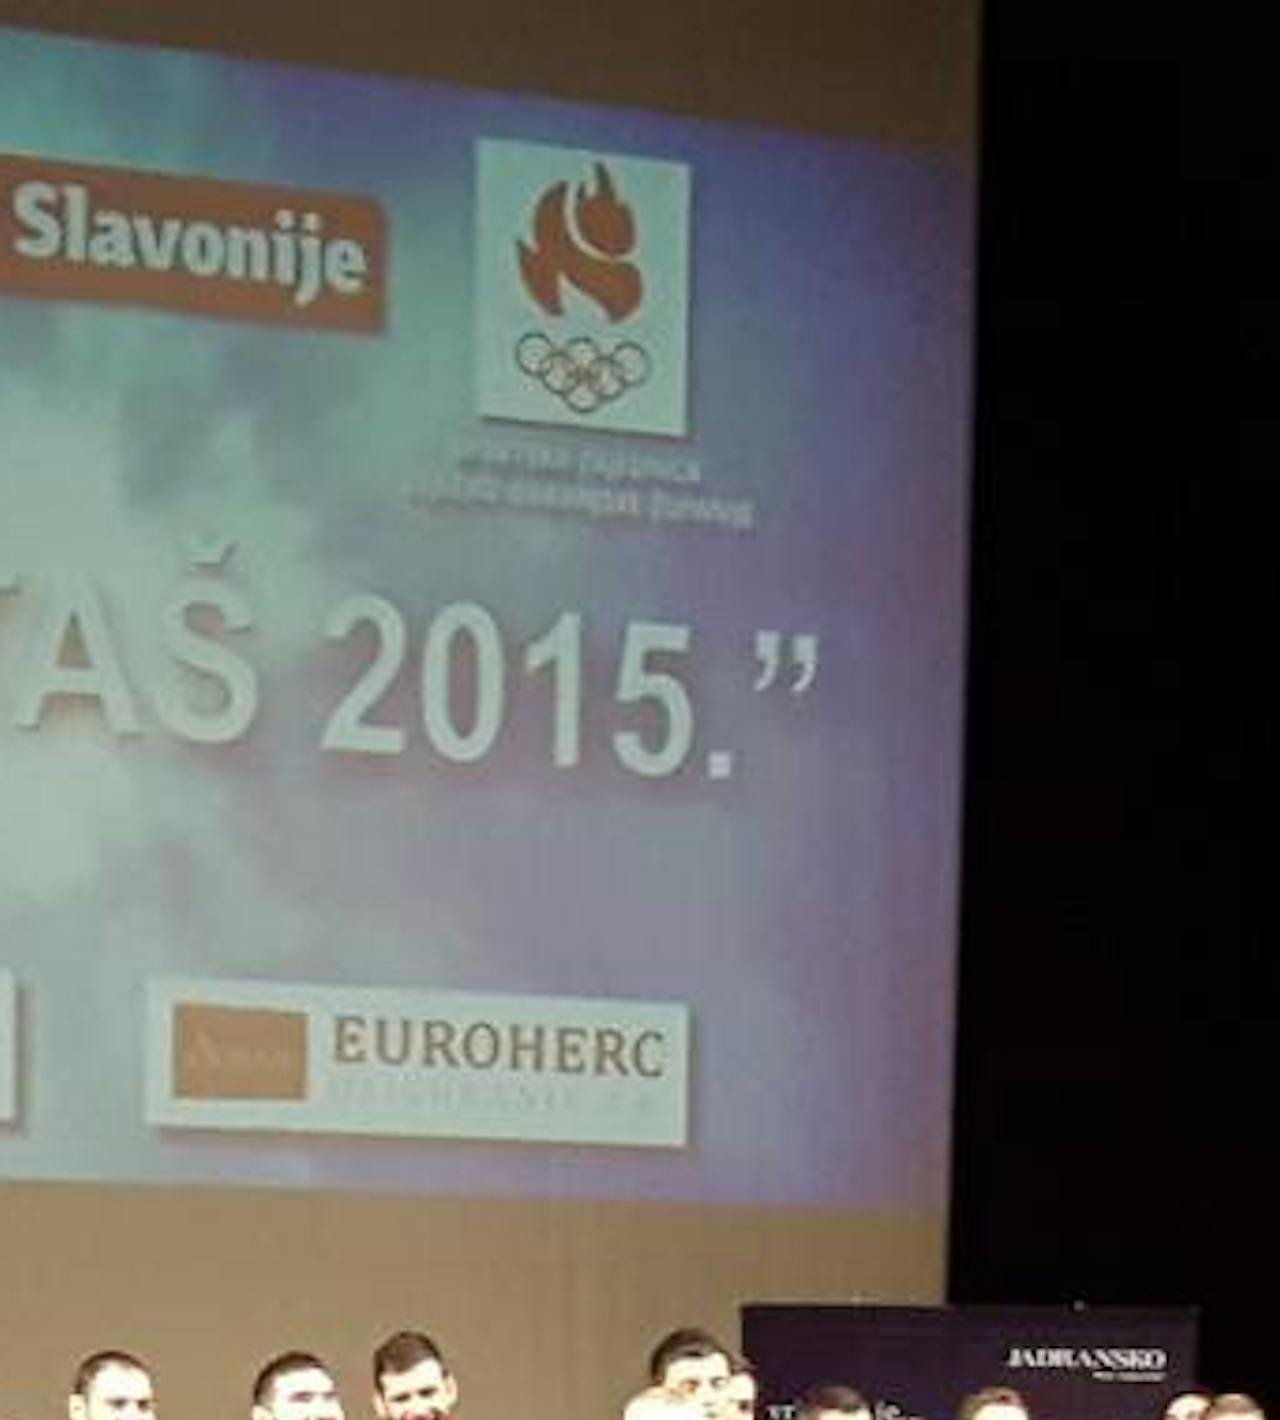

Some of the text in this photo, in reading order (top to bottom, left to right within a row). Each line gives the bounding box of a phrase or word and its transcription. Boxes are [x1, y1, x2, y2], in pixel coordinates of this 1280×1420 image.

[12, 180, 370, 306] Slavonije
[333, 1014, 665, 1079] EUROHERC
[1007, 1347, 1167, 1371] JADRANSKO
